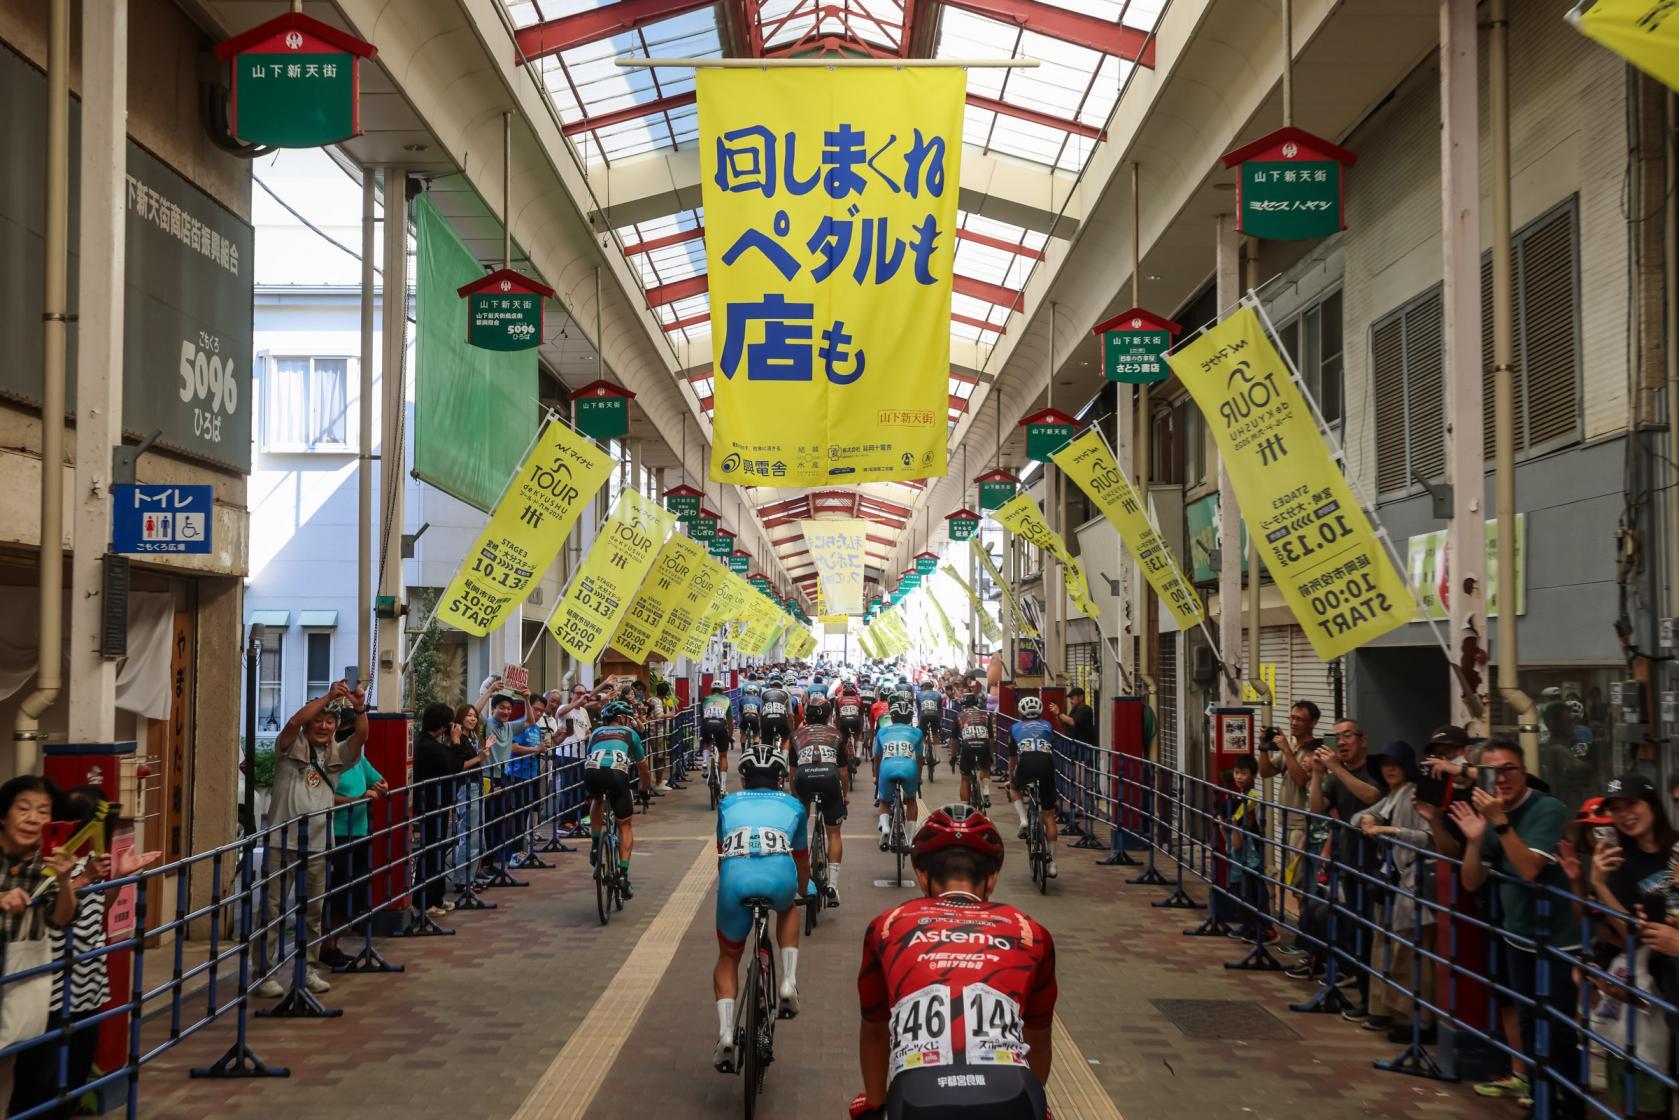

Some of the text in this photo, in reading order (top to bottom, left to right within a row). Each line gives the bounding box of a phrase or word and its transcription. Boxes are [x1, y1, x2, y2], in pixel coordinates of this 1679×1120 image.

[252, 64, 336, 78] 山下新天街
[715, 124, 946, 200] 回しまくれ
[1254, 170, 1328, 182] 山下新天街
[721, 203, 943, 287] ペダルも
[480, 300, 532, 309] 山下新天街
[508, 325, 536, 334] 5096
[719, 293, 866, 386] 店も
[1113, 336, 1162, 345] 山下新天街
[180, 340, 238, 415] 5096
[194, 408, 222, 442] ひろば
[880, 412, 934, 425] 山下新天街
[570, 450, 594, 470] マイナビ
[530, 465, 578, 506] TOUR
[134, 488, 193, 508] トイレ
[614, 521, 652, 553] TOUR
[501, 538, 528, 558] STAGE3
[472, 558, 522, 590] 10.13
[662, 554, 690, 577] TOUR
[574, 589, 610, 618] 10.13
[632, 606, 656, 627] 10.13
[554, 626, 592, 654] START
[563, 618, 596, 643] 10:00
[622, 628, 646, 646] 10:00
[616, 636, 644, 656] START
[654, 640, 676, 656] START
[764, 830, 787, 850] 91
[908, 928, 1011, 950] Astemo
